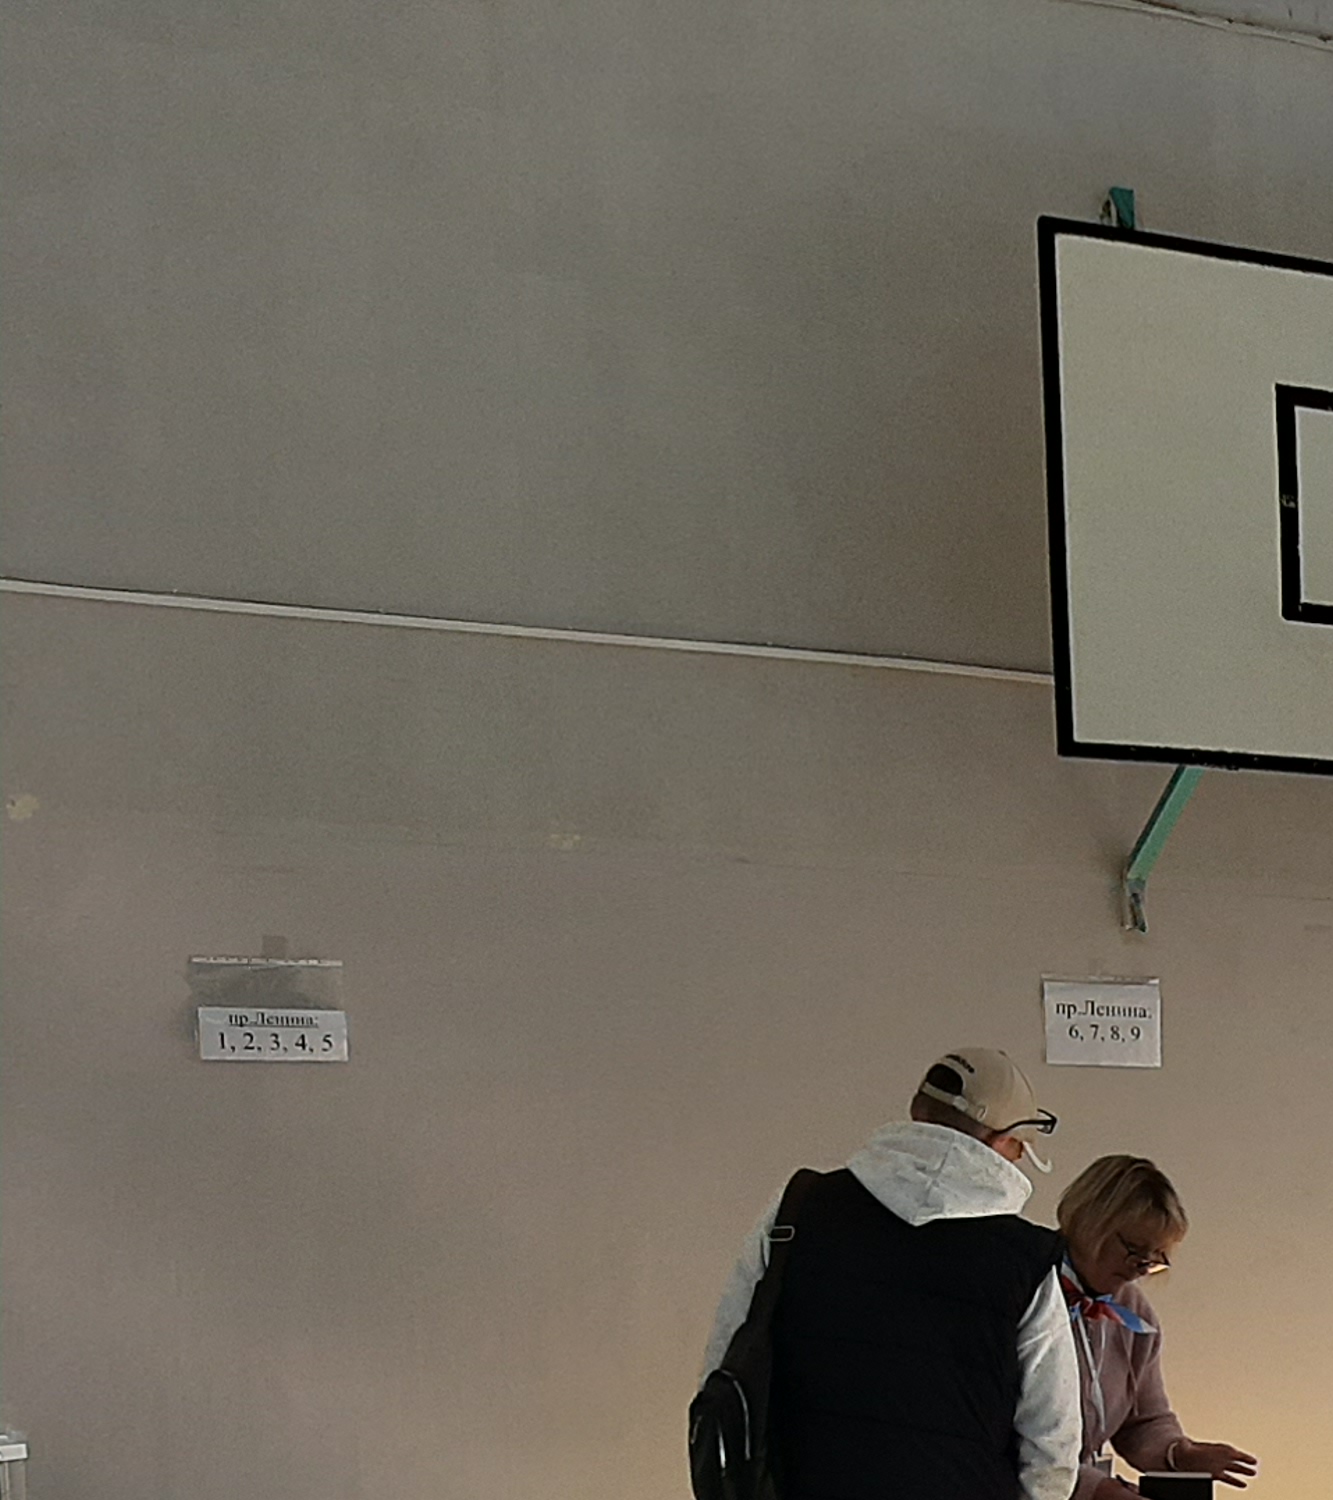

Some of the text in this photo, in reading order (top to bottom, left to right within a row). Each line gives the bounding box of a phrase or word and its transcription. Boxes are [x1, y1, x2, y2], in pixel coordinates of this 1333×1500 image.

[218, 1032, 333, 1053] 1, 2, 3, 4, 5
[1069, 1024, 1141, 1042] 6, 7, 8, 9
